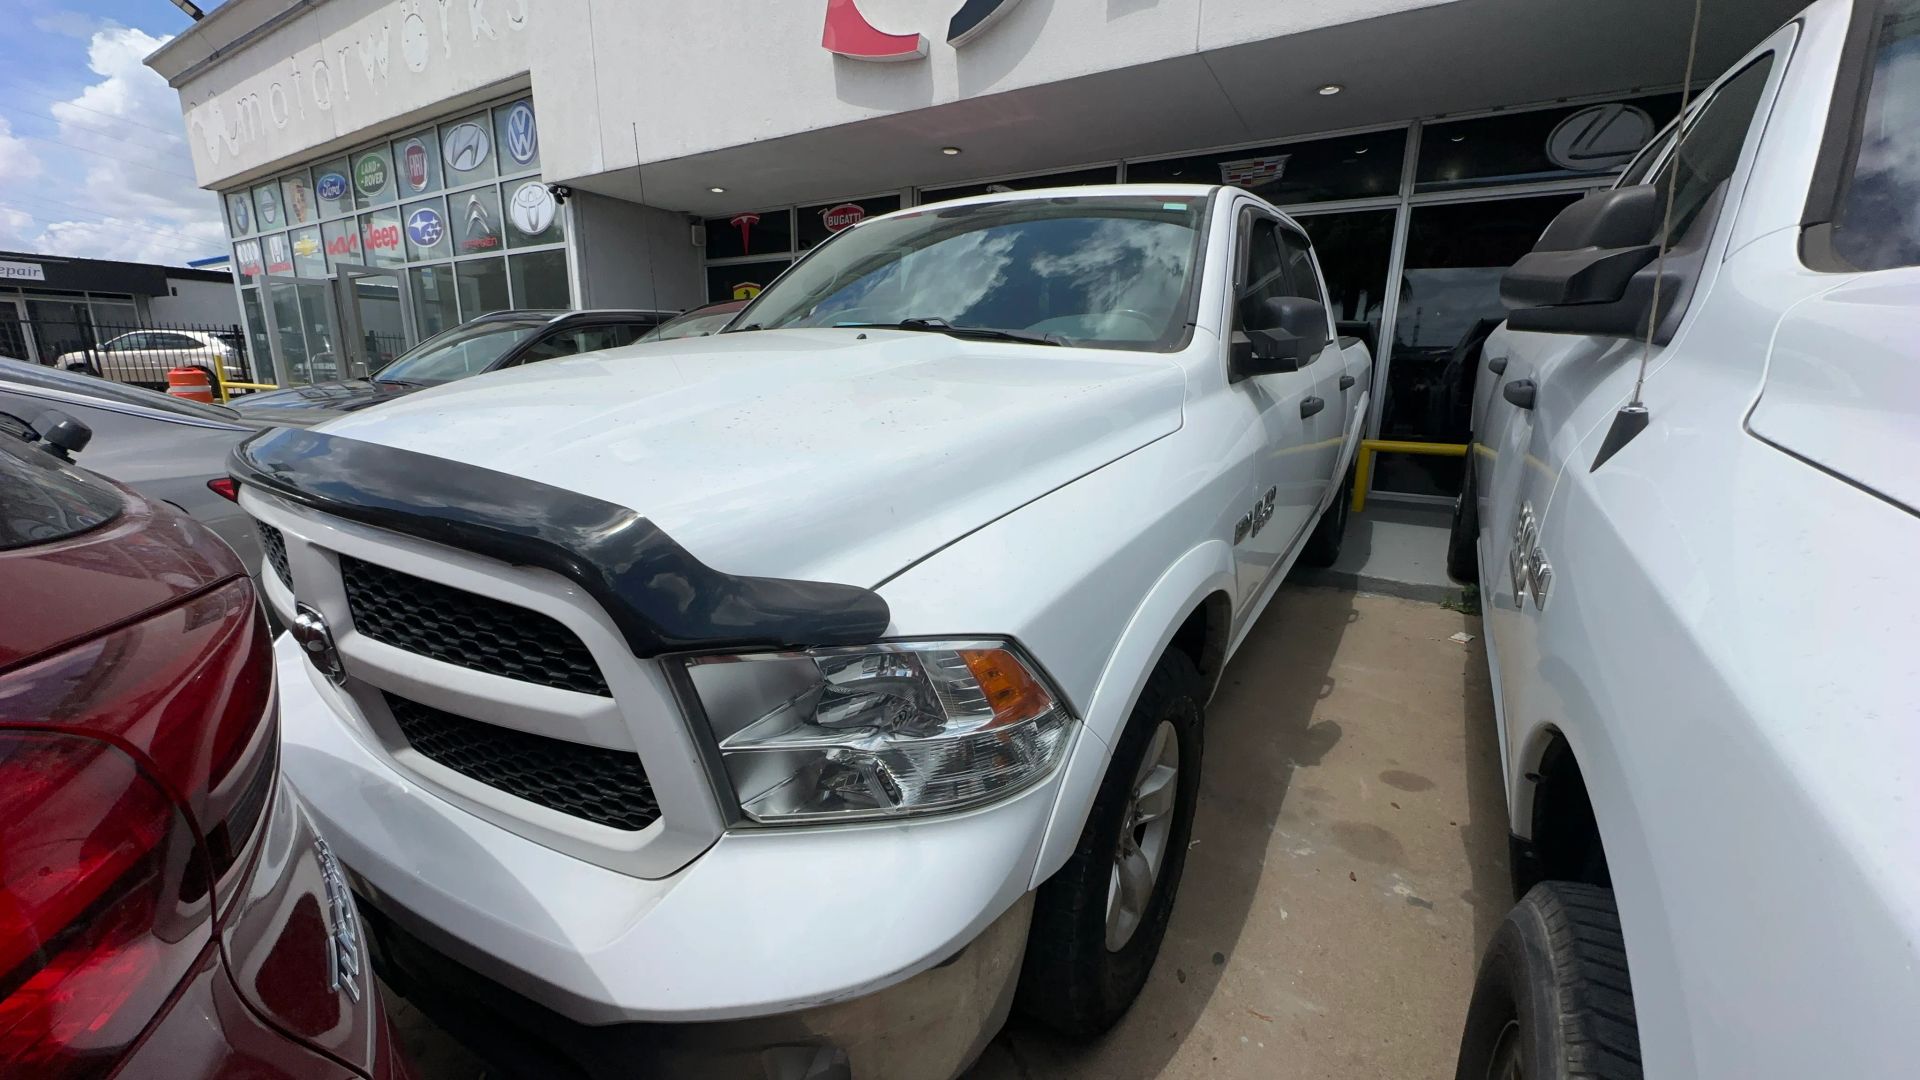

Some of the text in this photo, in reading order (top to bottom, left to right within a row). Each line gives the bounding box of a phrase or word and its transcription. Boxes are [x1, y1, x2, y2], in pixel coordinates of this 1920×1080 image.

[361, 161, 377, 175] LAND
[408, 153, 425, 177] FIAT
[322, 178, 340, 197] Ford
[364, 172, 384, 187] ROVER
[828, 212, 861, 227] BUGATTI
[364, 223, 399, 251] Jeep
